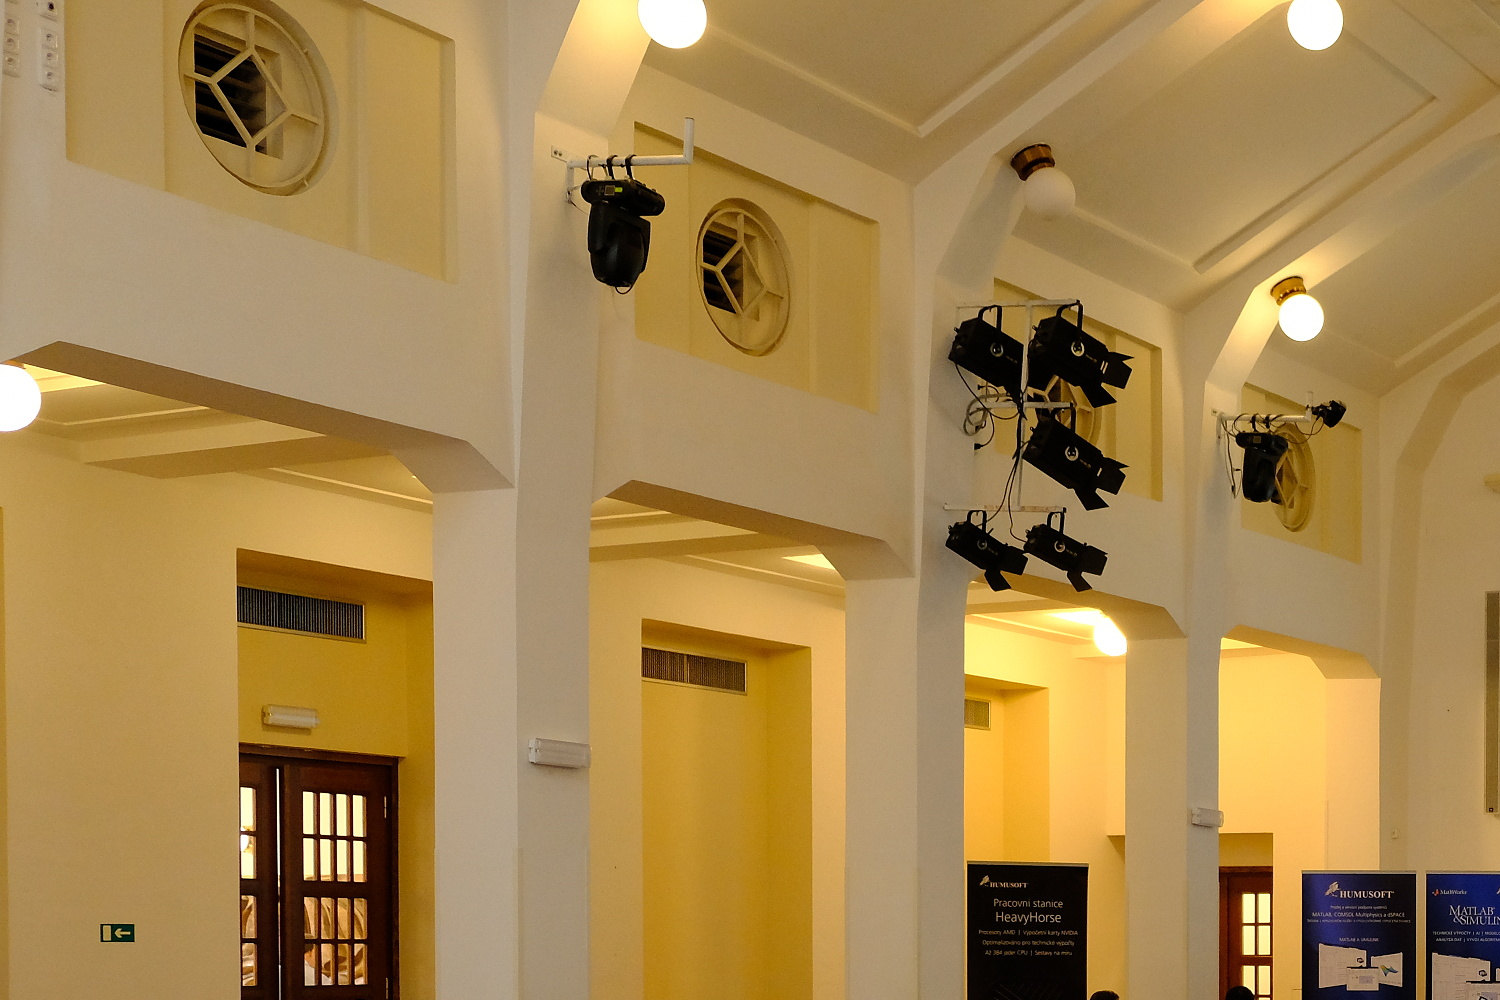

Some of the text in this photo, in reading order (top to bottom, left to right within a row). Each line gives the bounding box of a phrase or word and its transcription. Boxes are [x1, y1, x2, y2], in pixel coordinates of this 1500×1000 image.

[994, 899, 1063, 908] Pracovní stanice
[996, 912, 1061, 925] HeavyHorse
